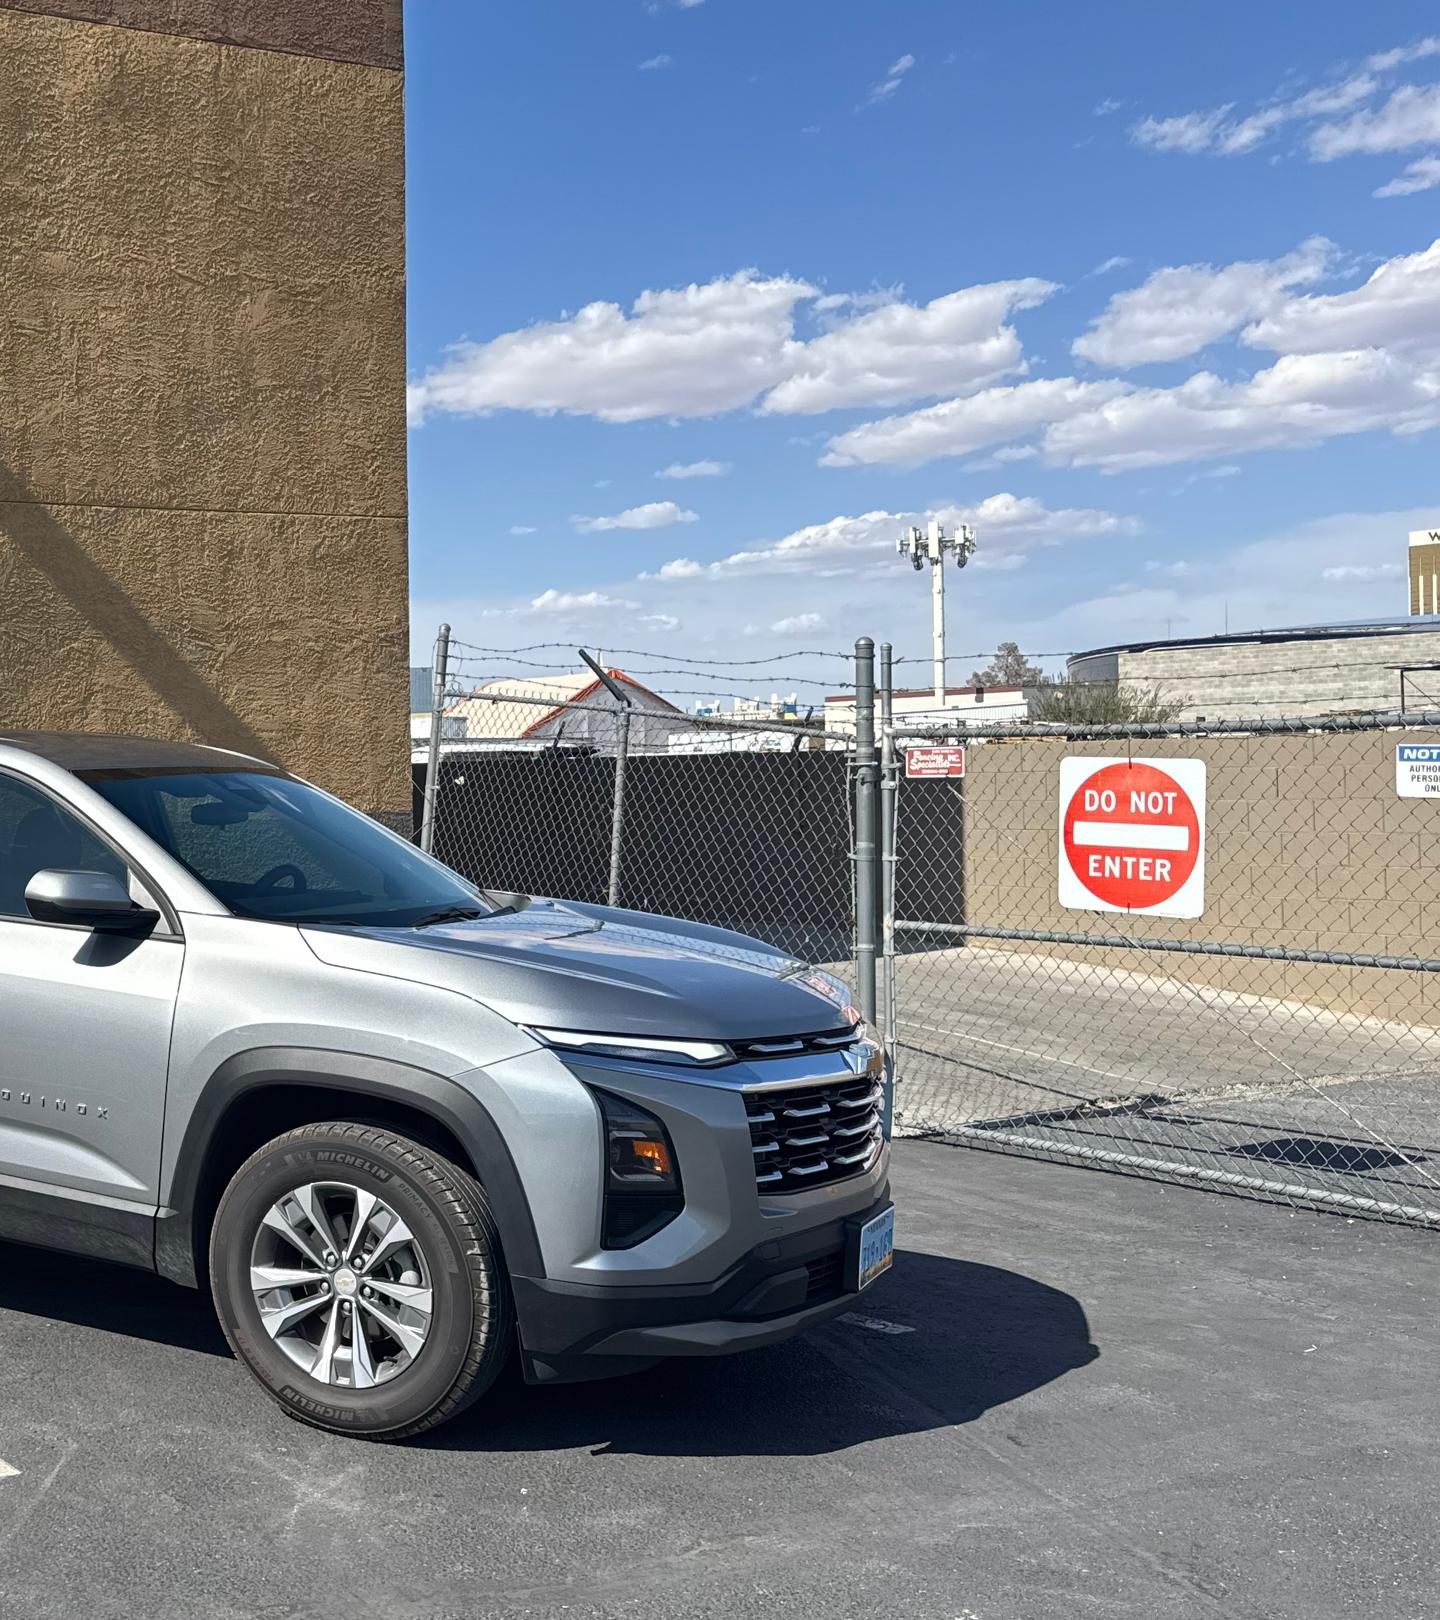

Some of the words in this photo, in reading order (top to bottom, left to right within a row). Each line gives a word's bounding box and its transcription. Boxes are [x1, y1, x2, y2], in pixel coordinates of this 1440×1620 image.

[1410, 774, 1440, 783] PERSO
[1084, 789, 1117, 813] DO
[1130, 790, 1178, 815] NOT
[1088, 854, 1171, 882] ENTER
[316, 1151, 390, 1181] MICHELIN
[282, 1387, 354, 1422] MICHELIN
